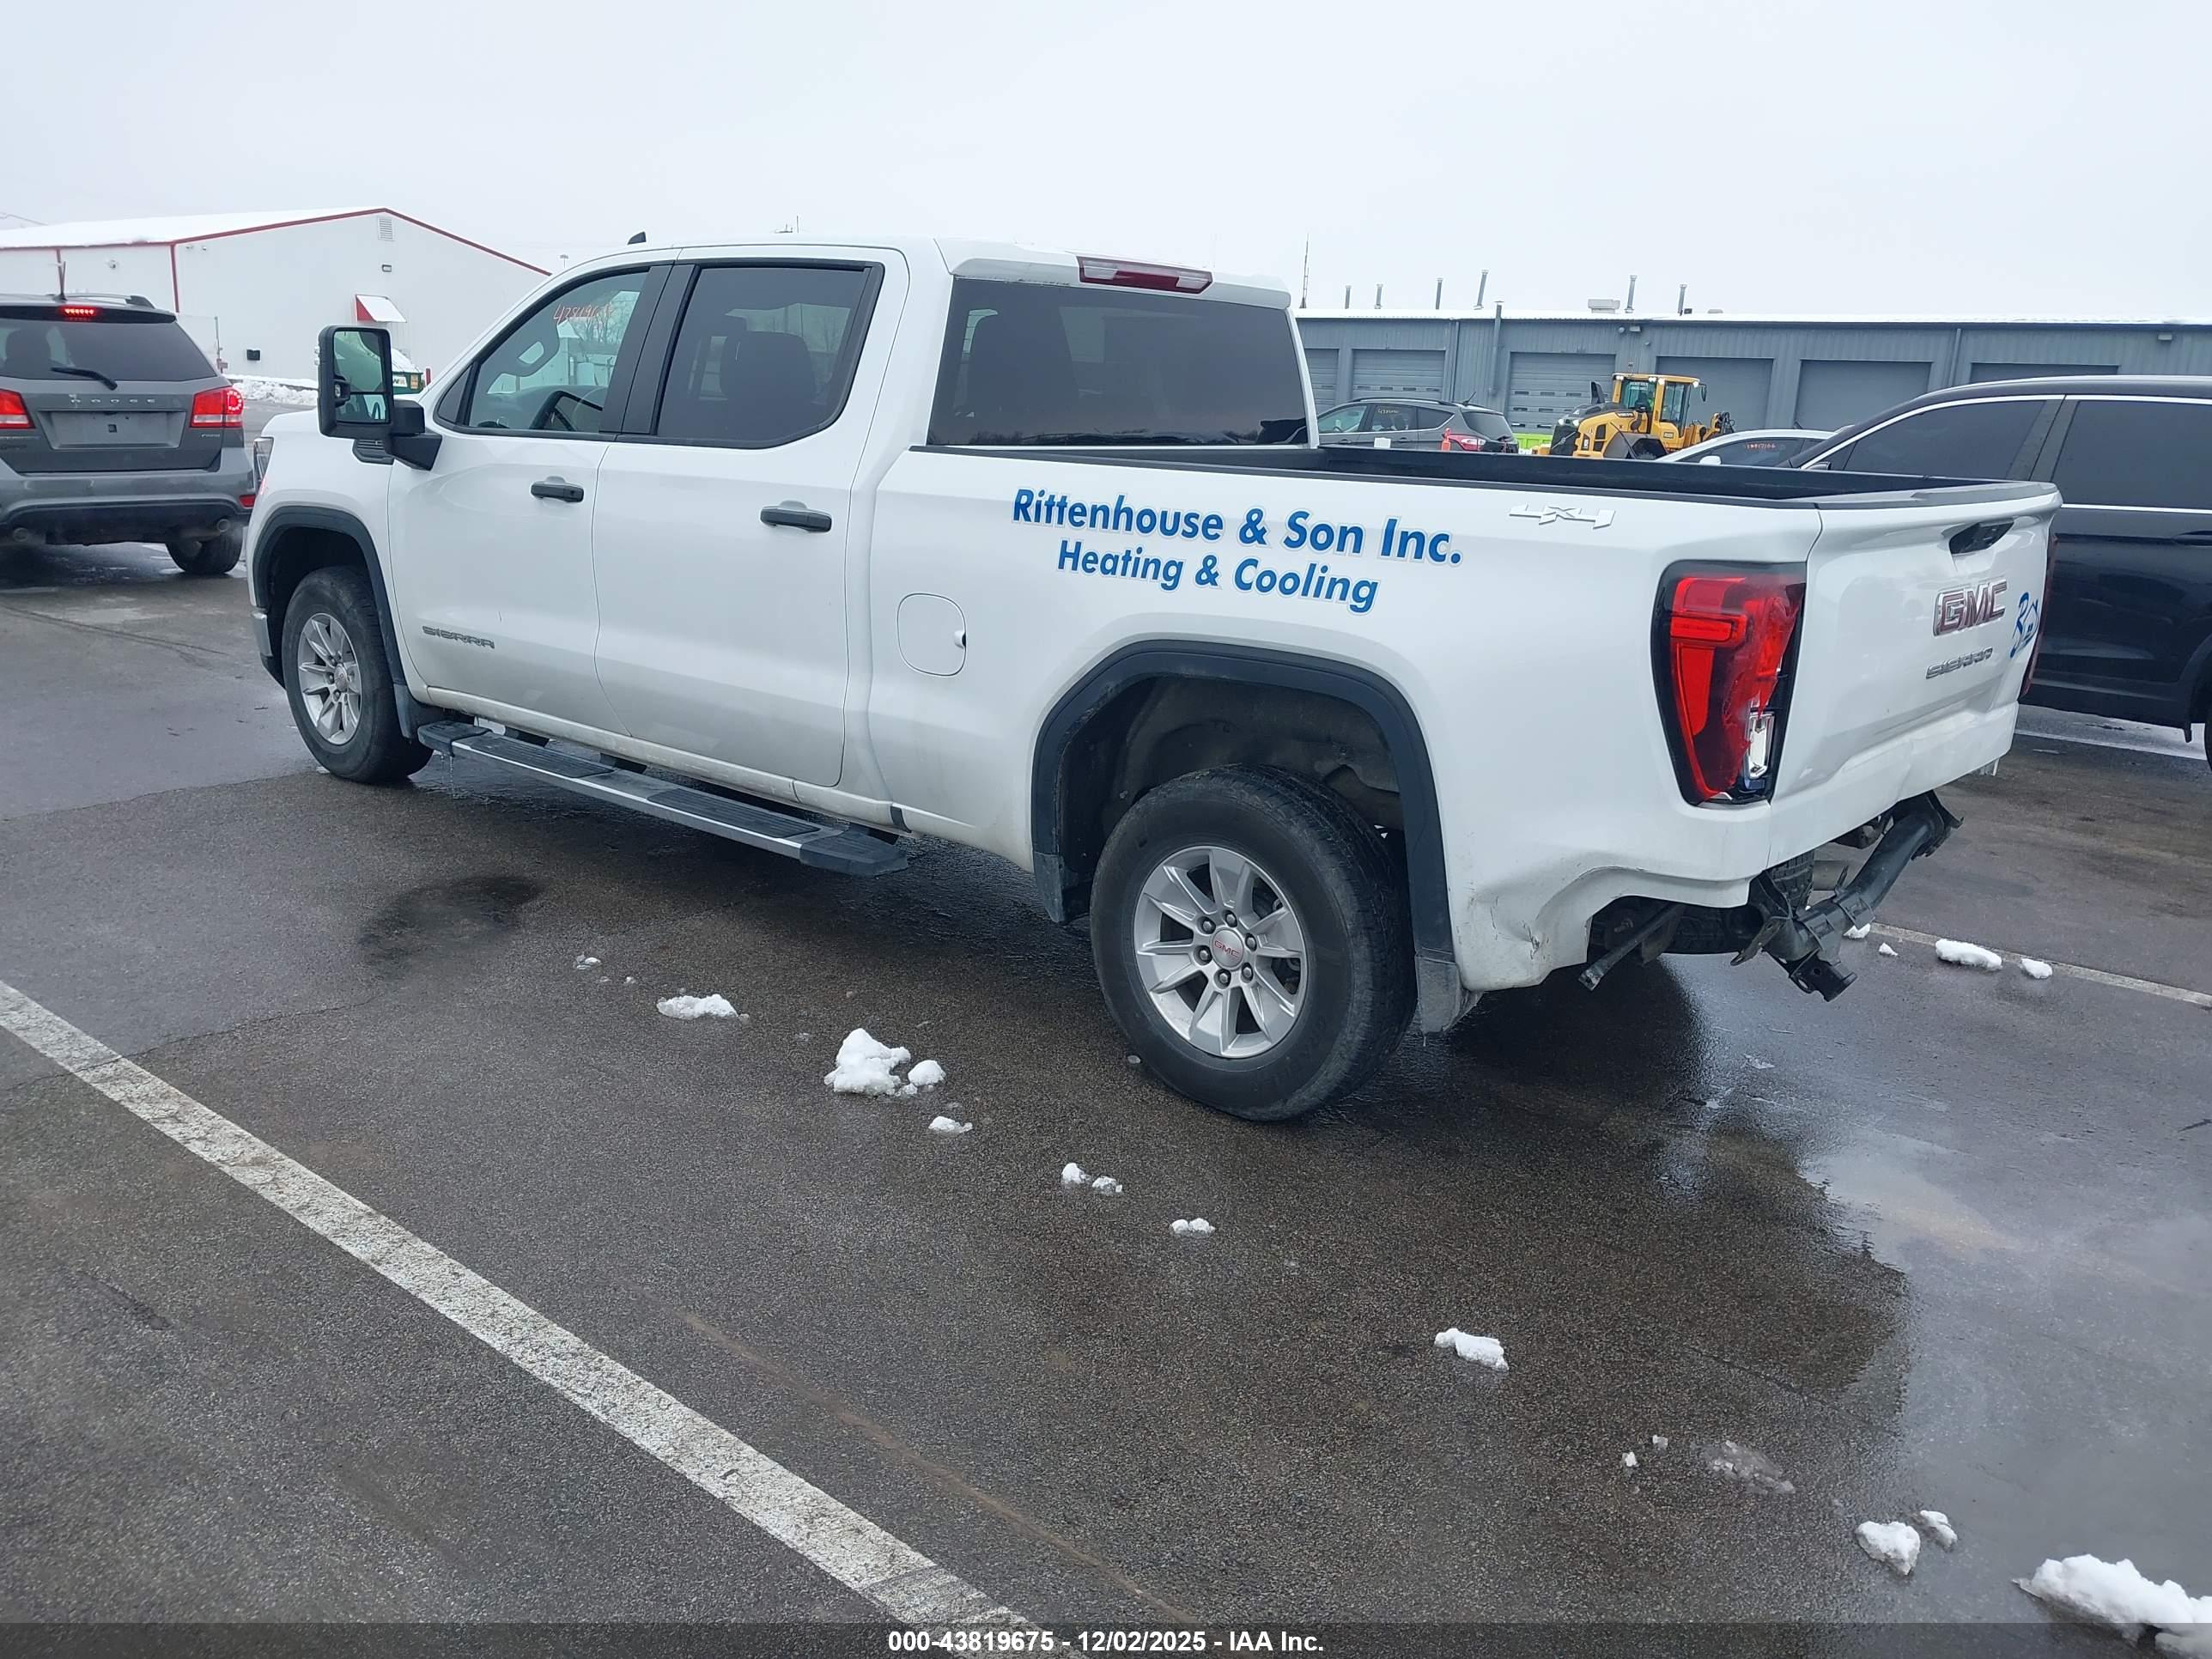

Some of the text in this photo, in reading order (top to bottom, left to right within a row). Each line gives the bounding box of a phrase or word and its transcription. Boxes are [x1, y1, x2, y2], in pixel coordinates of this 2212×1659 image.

[1012, 488, 1462, 564] Rittenhouse & Son Inc.
[1057, 539, 1379, 613] Heating & Cooling
[422, 625, 495, 649] SIERRA
[1933, 579, 2008, 637] GMC
[1214, 940, 1241, 958] GMC
